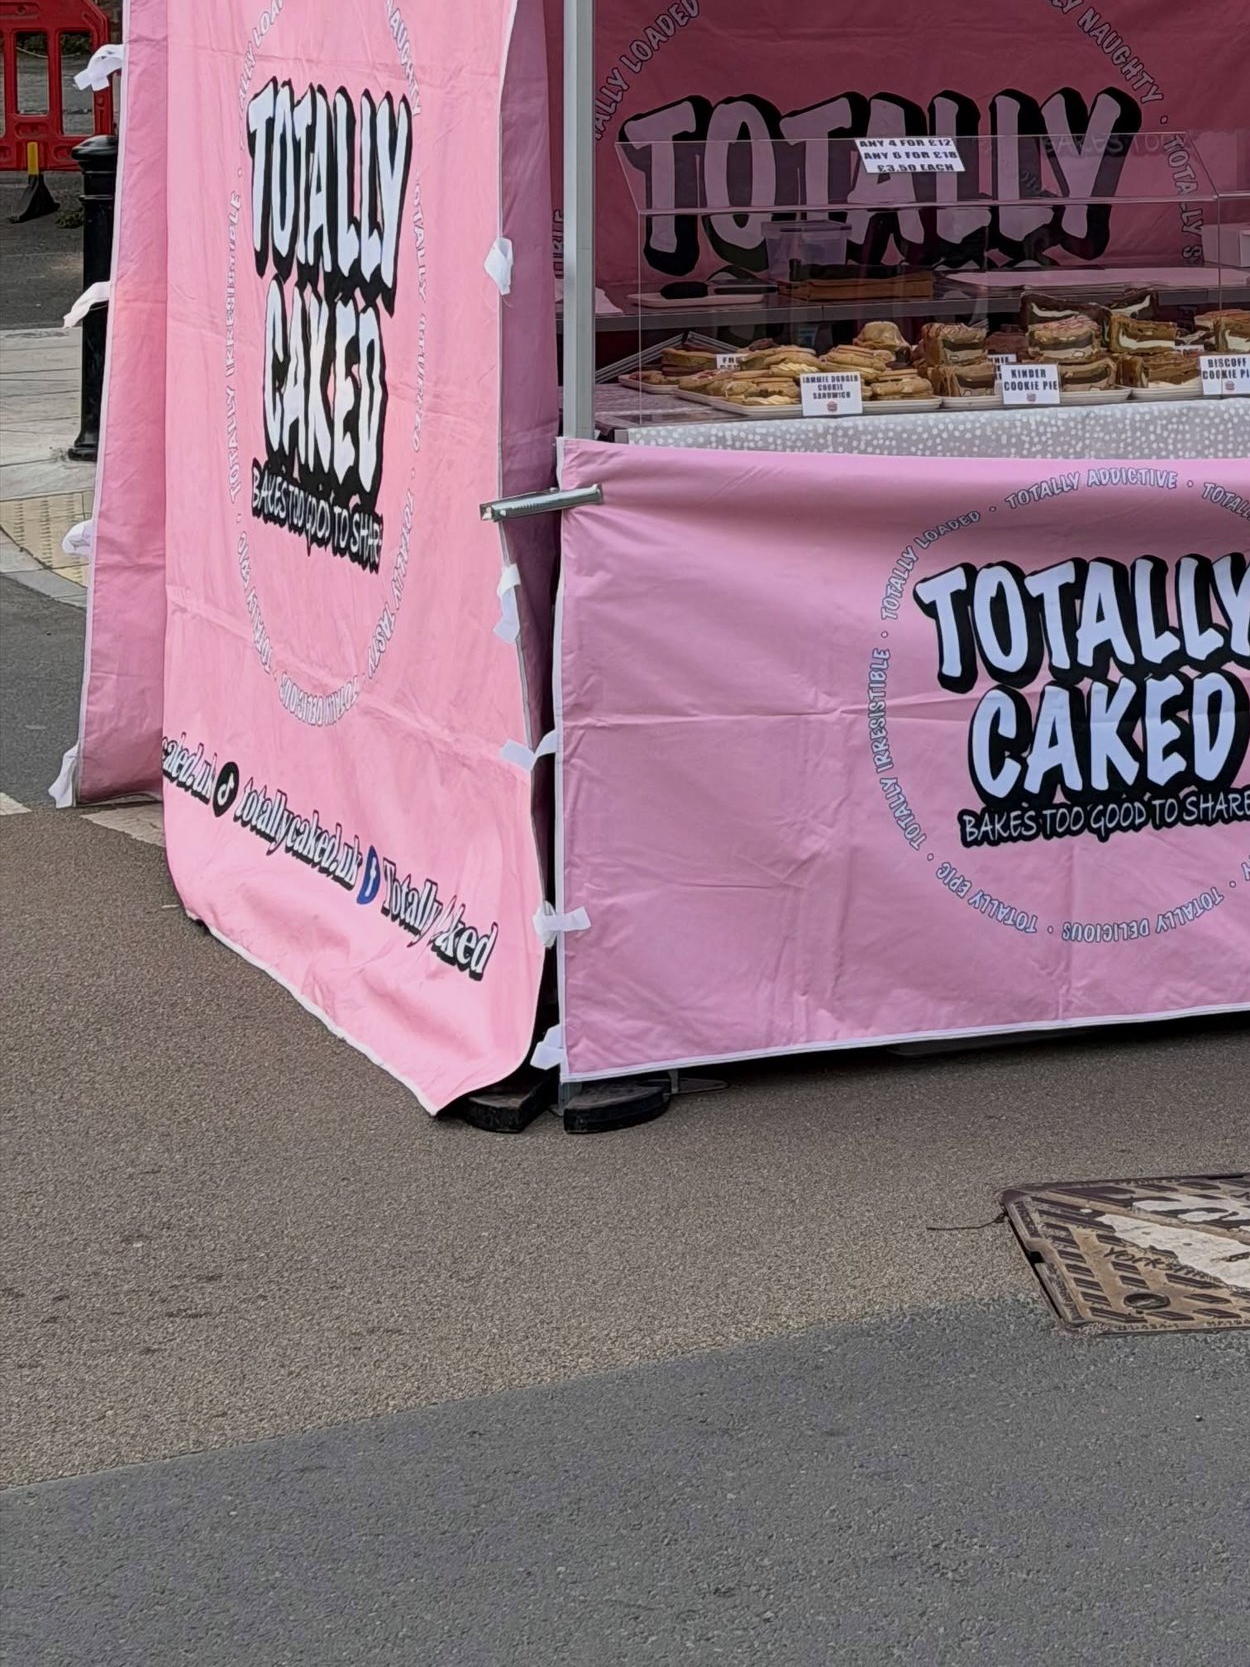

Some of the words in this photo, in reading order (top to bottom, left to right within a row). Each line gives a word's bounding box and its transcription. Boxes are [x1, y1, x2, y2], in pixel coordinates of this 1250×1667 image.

[1077, 6, 1164, 106] NAUGHTY
[860, 139, 884, 148] ANY
[888, 139, 897, 147] 4
[901, 139, 925, 147] FOR
[929, 138, 952, 146] £12
[864, 152, 888, 160] ANY
[905, 151, 930, 159] FOR
[618, 86, 1141, 276] TOTALLY
[877, 164, 917, 173] £3.50
[920, 163, 955, 172] EACH
[246, 76, 413, 318] TOTALLY
[262, 273, 388, 495] CAKED
[1003, 381, 1040, 391] COOKIE
[1042, 380, 1058, 391] PIE
[1011, 369, 1046, 379] KINDER
[1202, 369, 1238, 380] COOKIE
[1207, 358, 1247, 368] BISCOFF
[226, 384, 242, 503] TOTALLY
[1003, 472, 1082, 511] TOTALLY
[1086, 467, 1180, 490] ADDICTIVE
[333, 504, 350, 550] TO
[391, 489, 414, 611] TOTALLY
[880, 546, 920, 621] TOTALLY
[915, 508, 981, 549] LOADED
[368, 601, 396, 680] TASTY
[868, 647, 896, 774] IRRESISTIBLE
[233, 777, 363, 891] totallycaked.uk
[877, 774, 928, 852] TOTALLY
[962, 807, 1038, 846] BAKES
[1042, 805, 1086, 835] TOO
[1089, 798, 1152, 843] GOOD
[1151, 796, 1182, 826] TO
[381, 856, 443, 948] Totally
[934, 859, 973, 900] EPIC
[967, 890, 1040, 936] TOTALLY
[1061, 919, 1152, 944] DELICIOUS
[1154, 885, 1226, 934] TOTALLY
